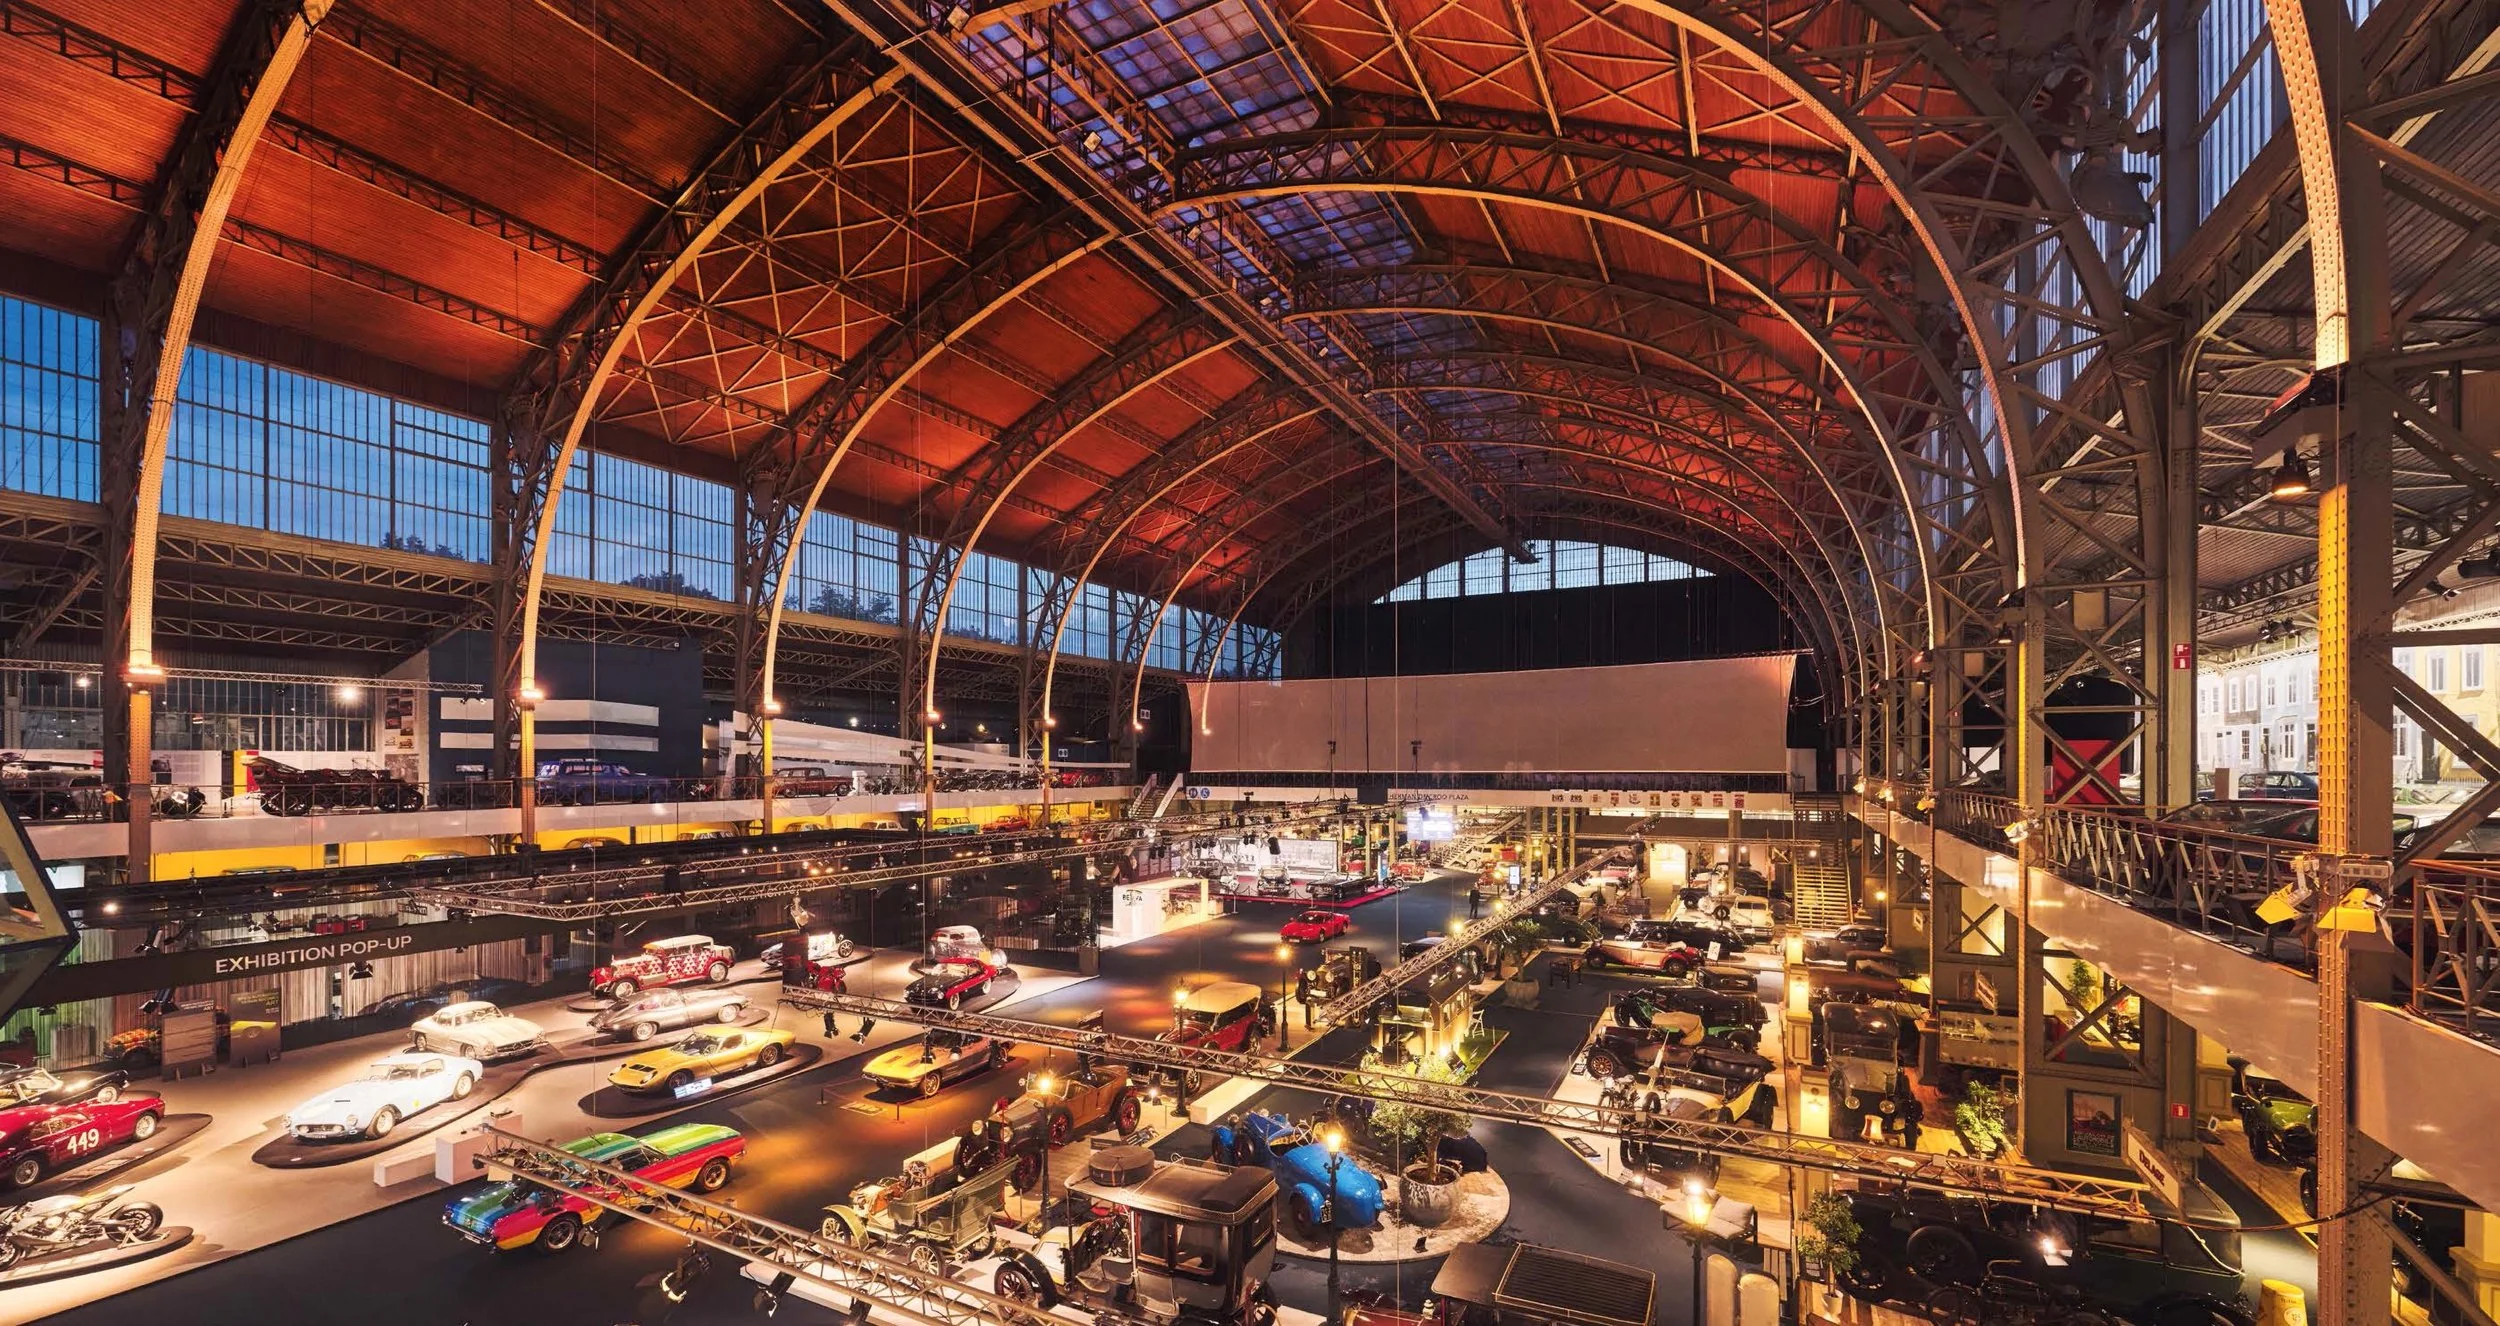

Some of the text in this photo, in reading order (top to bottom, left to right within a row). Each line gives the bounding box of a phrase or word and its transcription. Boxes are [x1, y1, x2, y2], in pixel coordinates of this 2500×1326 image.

[215, 935, 412, 974] EXHIBITION POP-UP
[67, 1128, 99, 1155] 449
